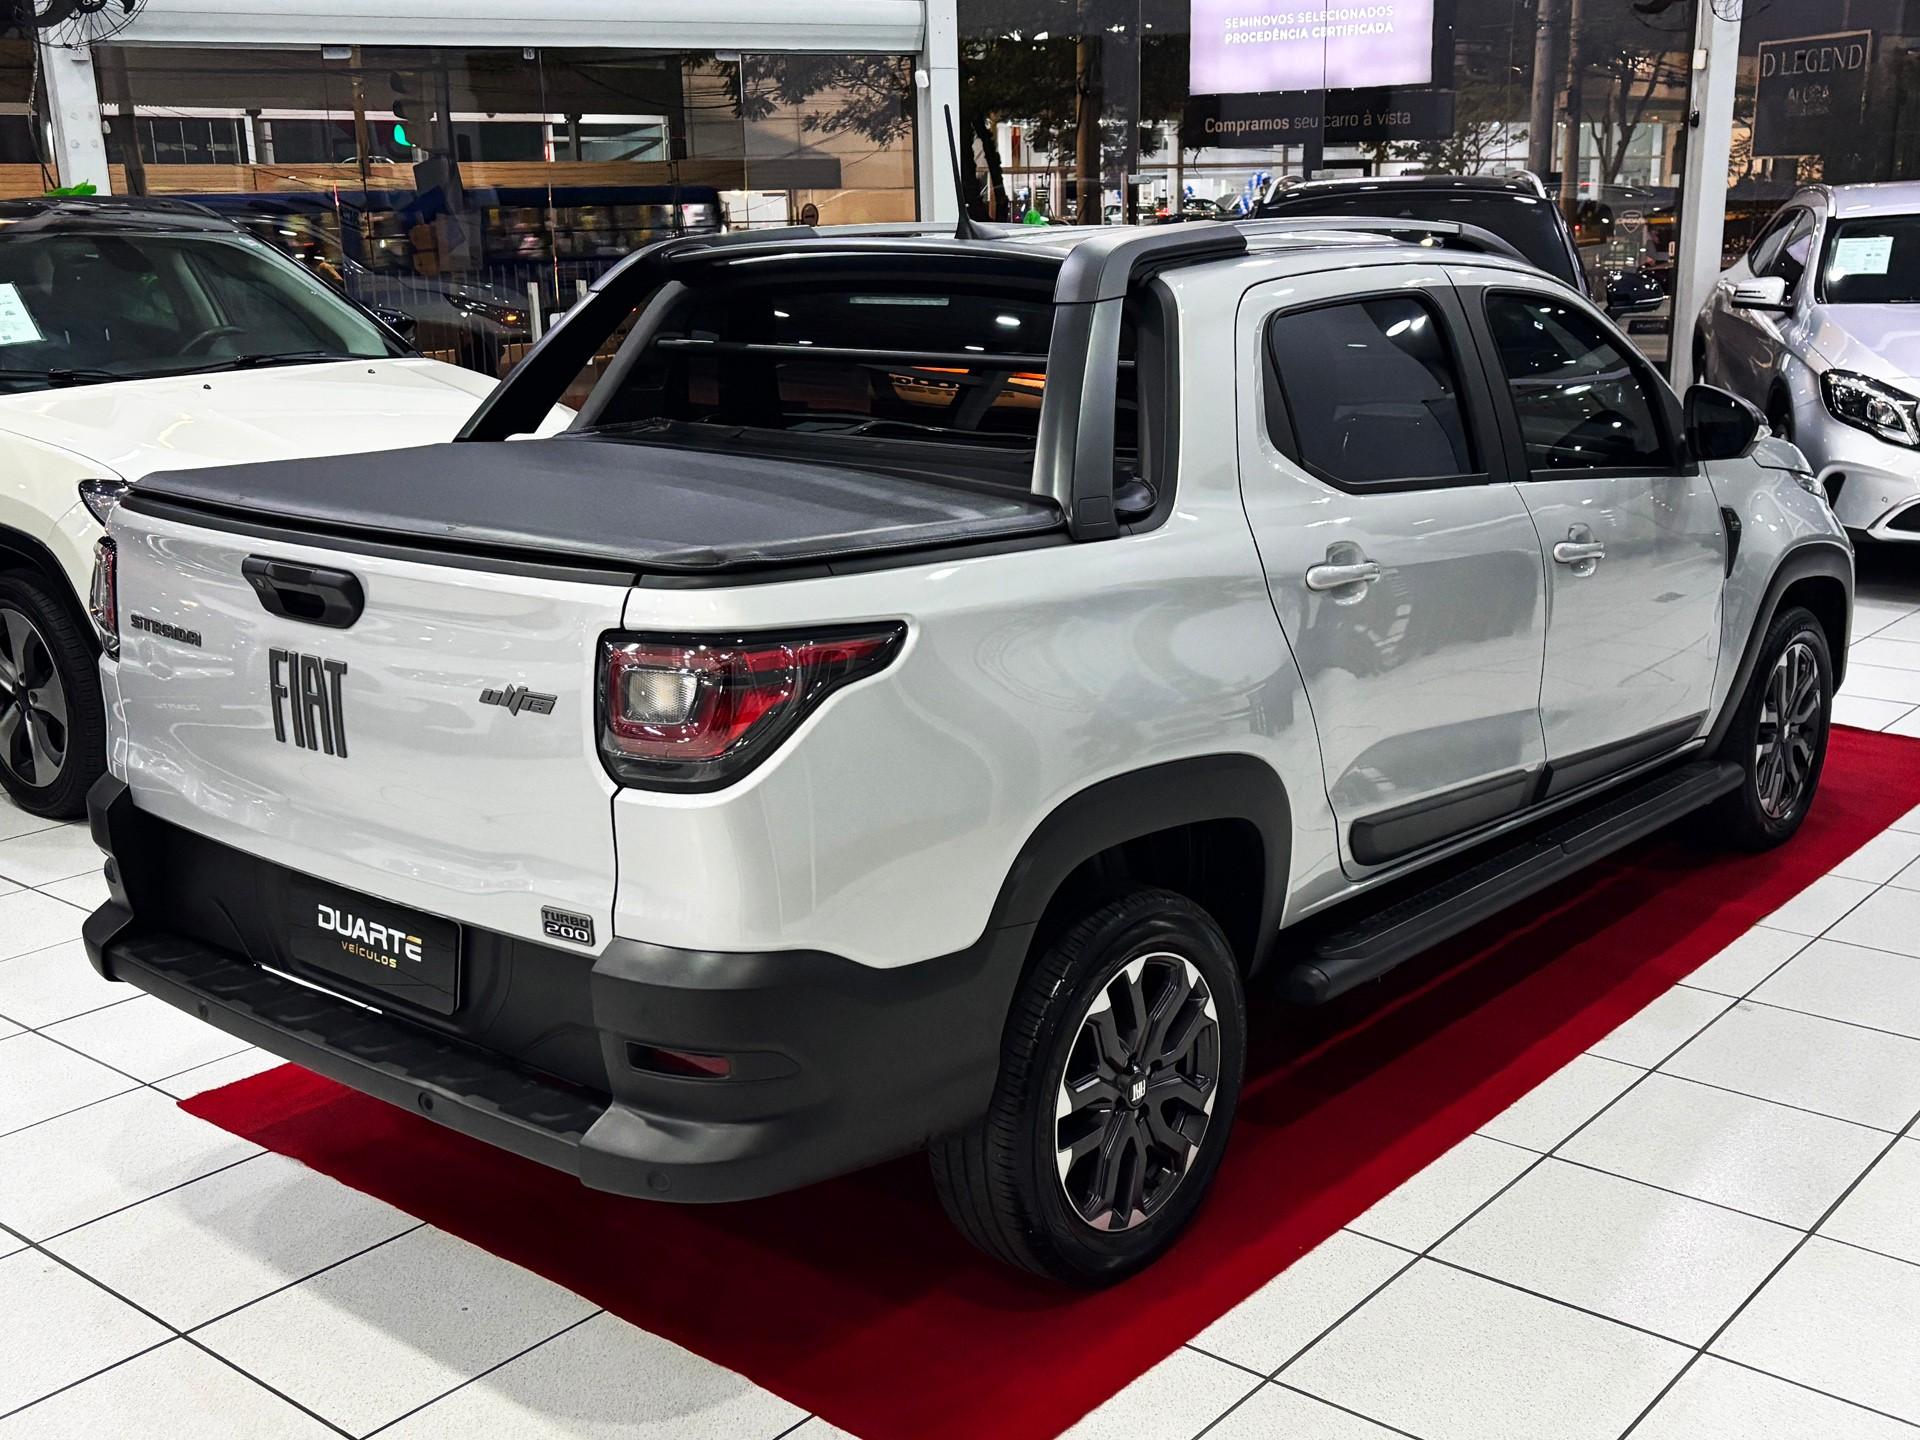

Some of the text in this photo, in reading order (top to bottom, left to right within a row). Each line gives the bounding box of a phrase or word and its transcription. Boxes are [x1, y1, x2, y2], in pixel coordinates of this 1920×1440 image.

[1224, 5, 1393, 29] SEMINOVOS SELECIONADOS
[1224, 22, 1393, 44] PROCEDÊNCIA CERTIFICADA
[1204, 109, 1411, 136] Compramos seu carro à vista
[131, 614, 202, 648] STRADA
[269, 647, 348, 758] FIAT
[318, 903, 422, 962] DUARTE
[541, 910, 589, 929] TURBO
[546, 922, 589, 942] 200
[341, 940, 397, 968] VEÍCULOS
